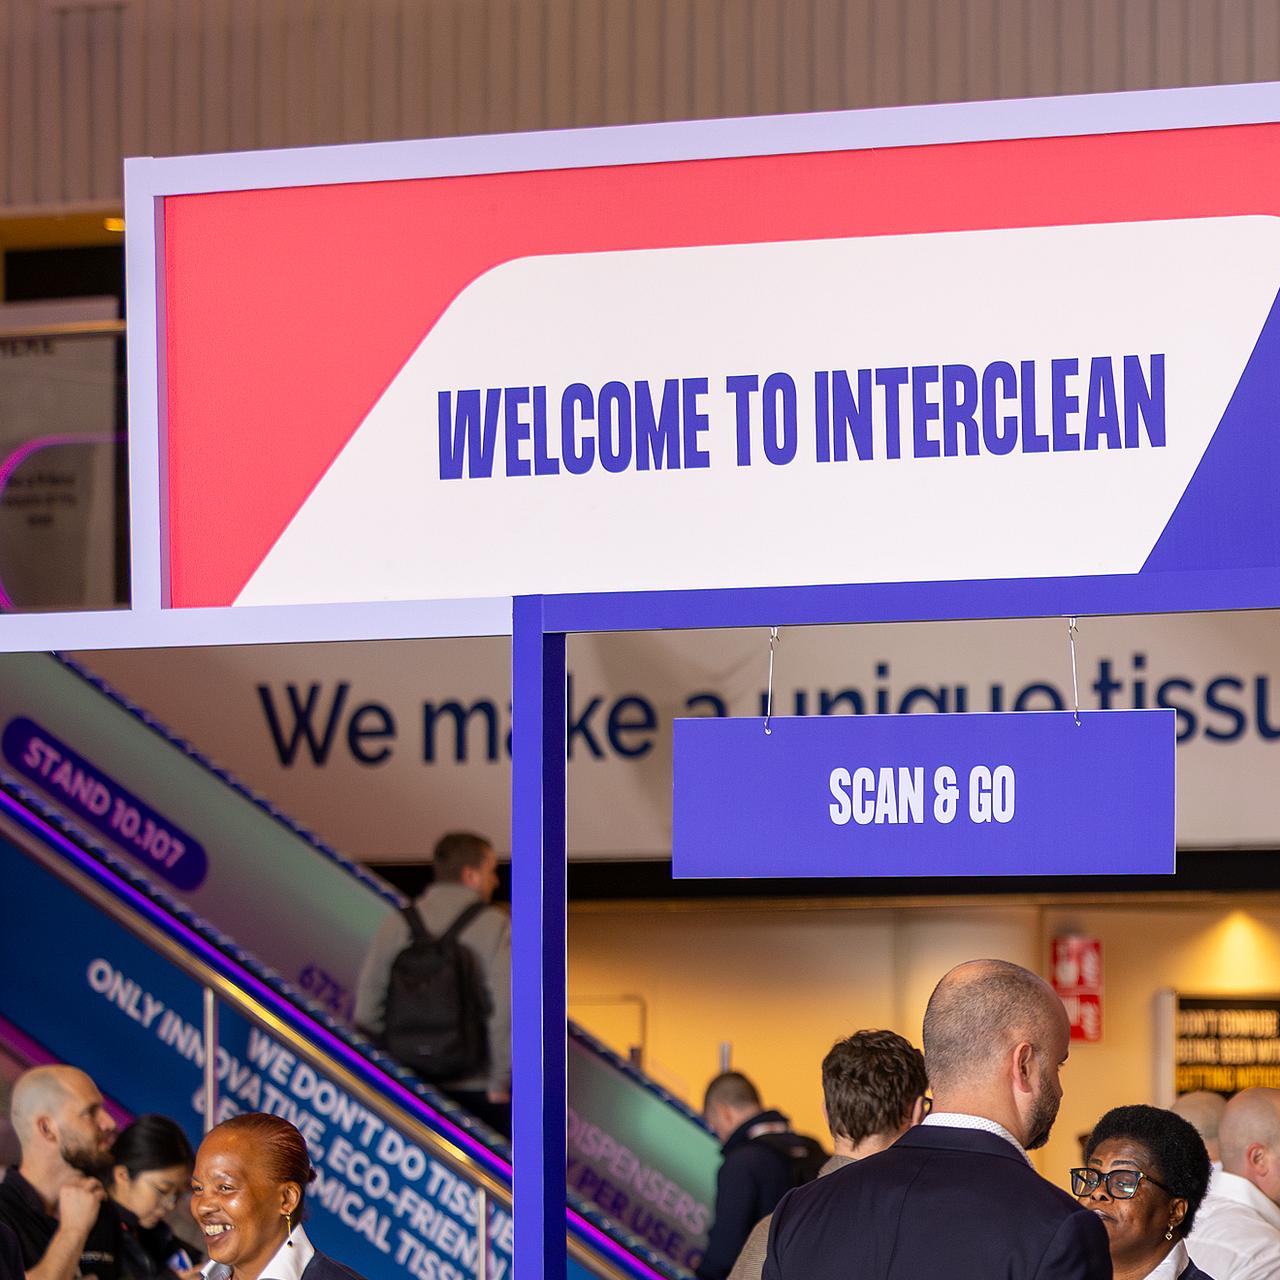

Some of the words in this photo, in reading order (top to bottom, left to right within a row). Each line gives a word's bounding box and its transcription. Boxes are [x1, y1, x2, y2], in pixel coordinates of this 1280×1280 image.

[438, 378, 711, 481] WELCOME
[726, 372, 799, 468] TO
[815, 354, 1167, 464] INTERCLEAN
[258, 682, 396, 768] We
[423, 672, 659, 764] mke
[25, 736, 111, 814] STAND
[111, 799, 187, 869] 10.107
[829, 767, 925, 825] SCAN
[934, 766, 959, 823] &
[969, 764, 1016, 824] GO
[86, 957, 165, 1029] ONLY
[248, 1028, 296, 1090] WE
[290, 1064, 384, 1148] DON'T
[377, 1126, 427, 1181] DO
